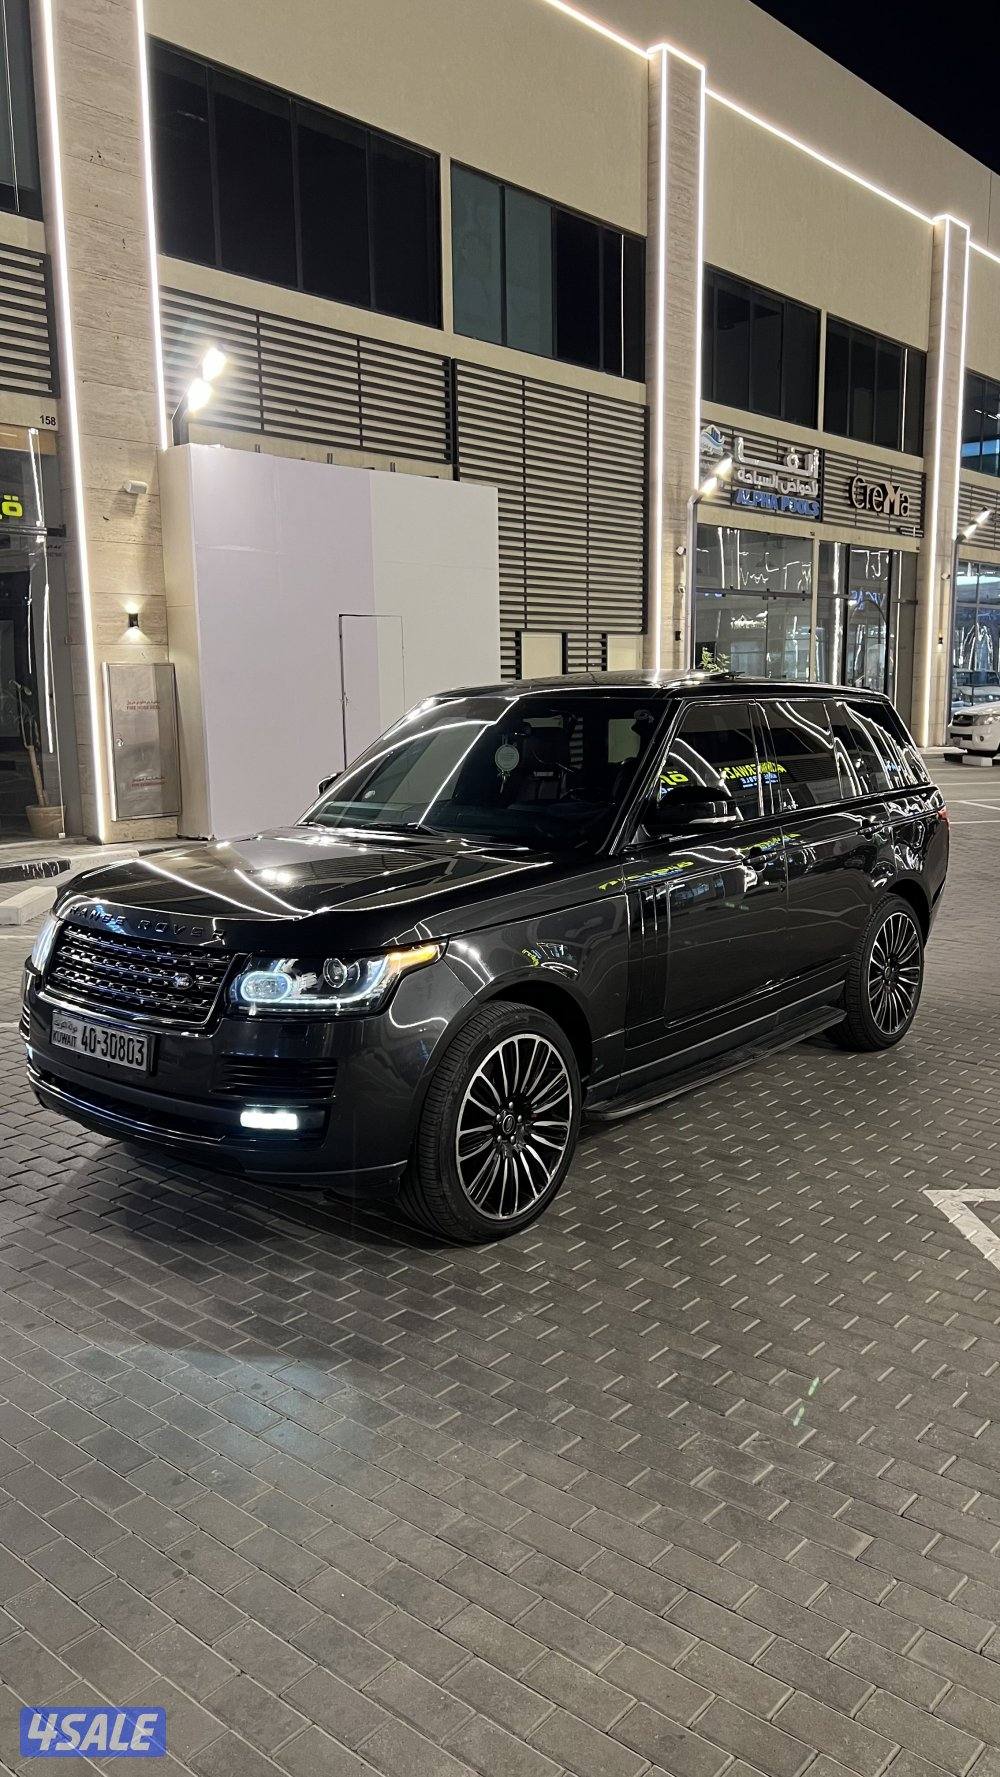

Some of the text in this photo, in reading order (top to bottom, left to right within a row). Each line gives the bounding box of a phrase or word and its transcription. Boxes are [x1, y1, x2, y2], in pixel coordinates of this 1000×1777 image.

[39, 414, 56, 426] 158
[736, 488, 820, 517] ALPHA POOLS
[52, 1029, 77, 1047] KUWAIT
[81, 1026, 145, 1067] 40-30803
